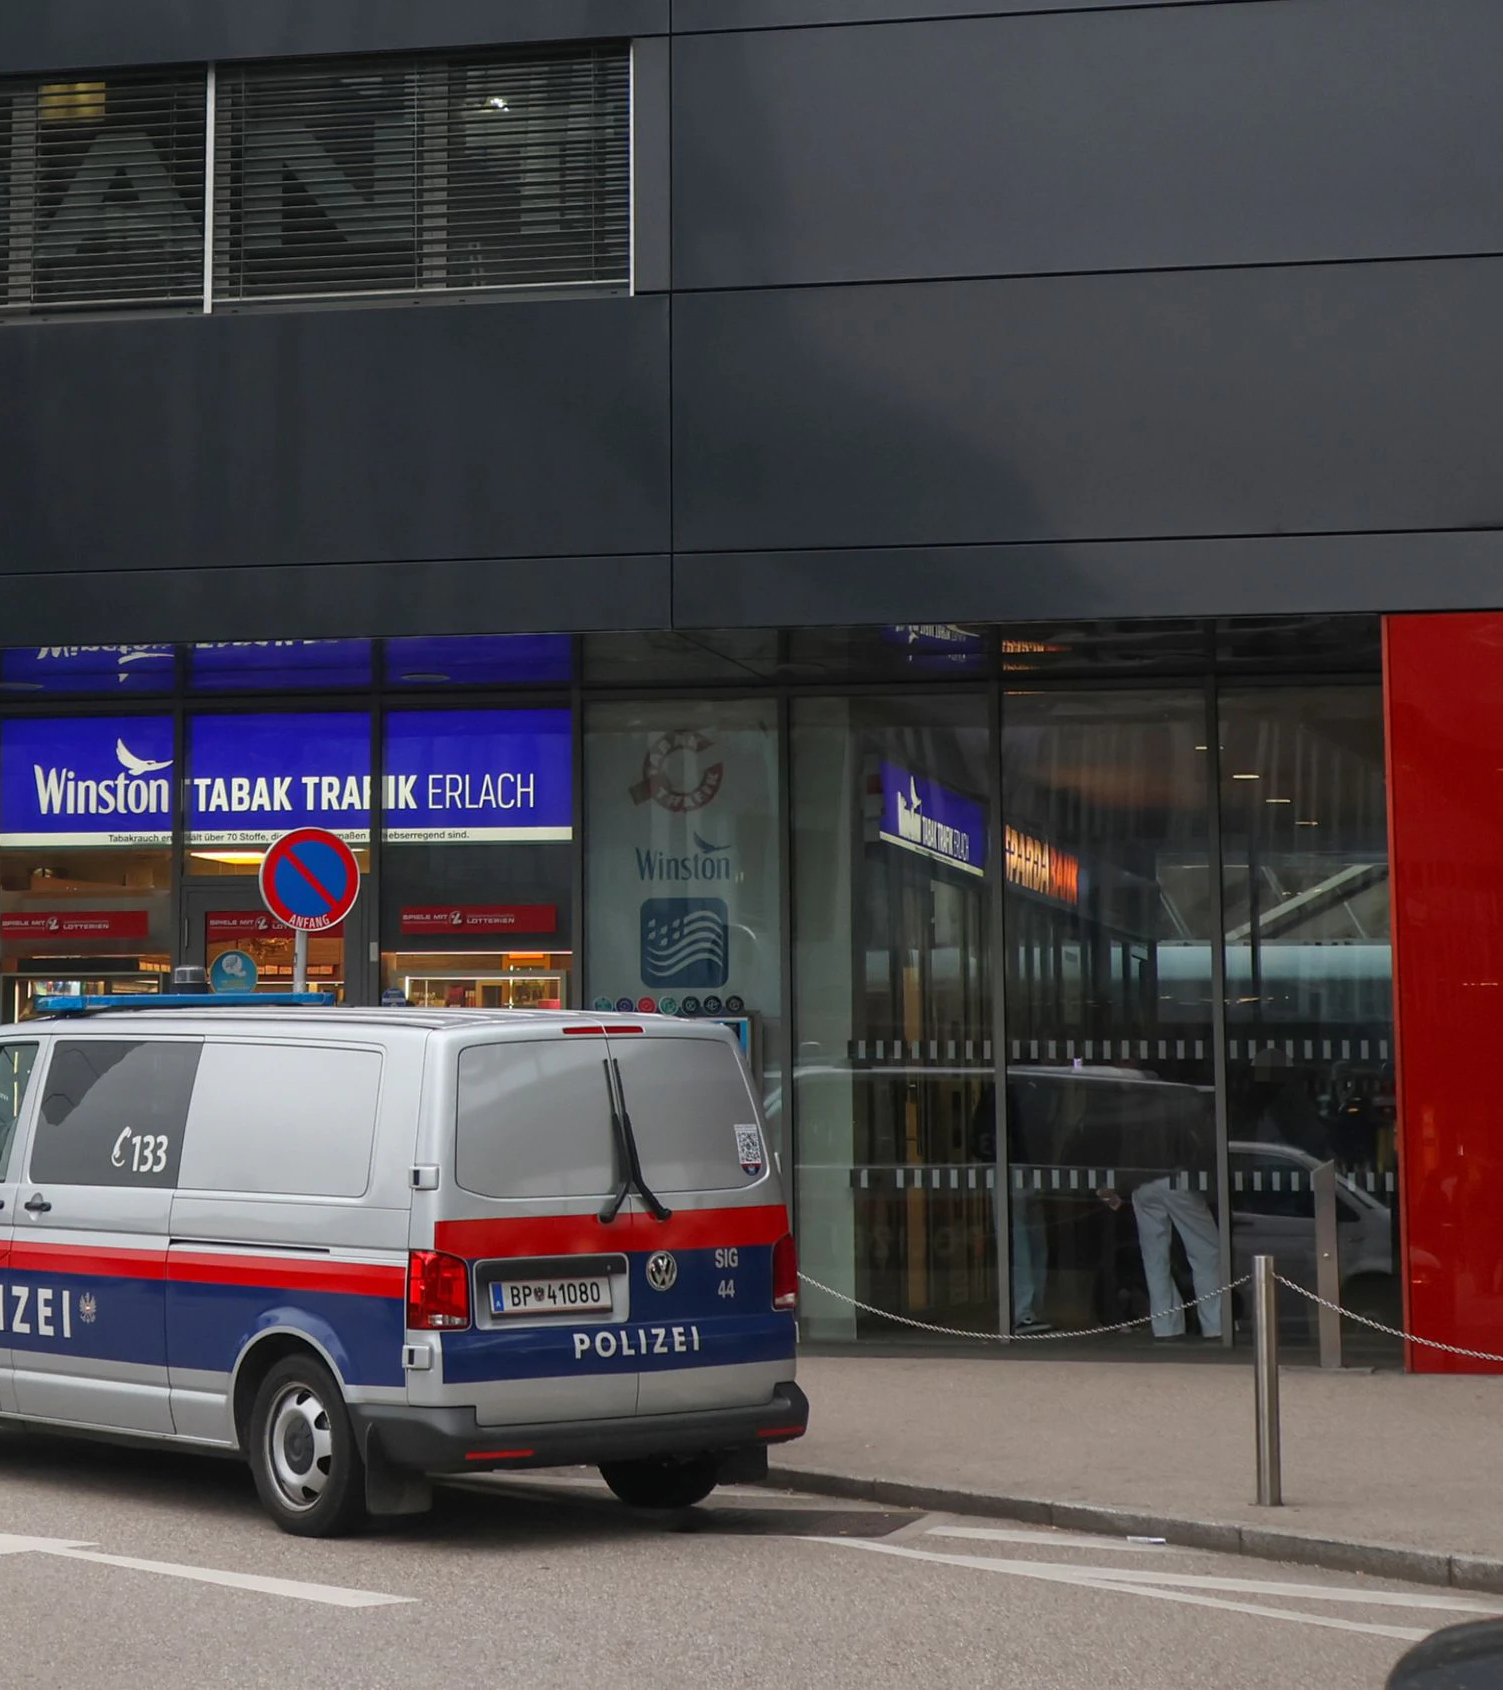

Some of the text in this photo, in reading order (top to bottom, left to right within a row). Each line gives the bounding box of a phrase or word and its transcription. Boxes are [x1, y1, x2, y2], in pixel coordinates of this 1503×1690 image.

[33, 763, 169, 815] Winston
[194, 776, 293, 812] TABAK
[428, 773, 535, 810] ERLACH
[108, 834, 159, 843] Tabakrauch
[204, 832, 225, 842] über
[227, 832, 238, 841] 70
[239, 832, 269, 843] Stoffe,
[447, 830, 470, 840] sind.
[635, 846, 730, 882] Winston
[288, 914, 330, 929] ANFANG
[131, 1135, 169, 1173] 133
[714, 1248, 739, 1268] SIG
[510, 1285, 532, 1307] BP
[547, 1281, 601, 1305] 41080
[717, 1279, 736, 1298] 44
[572, 1325, 700, 1360] POLIZEI
